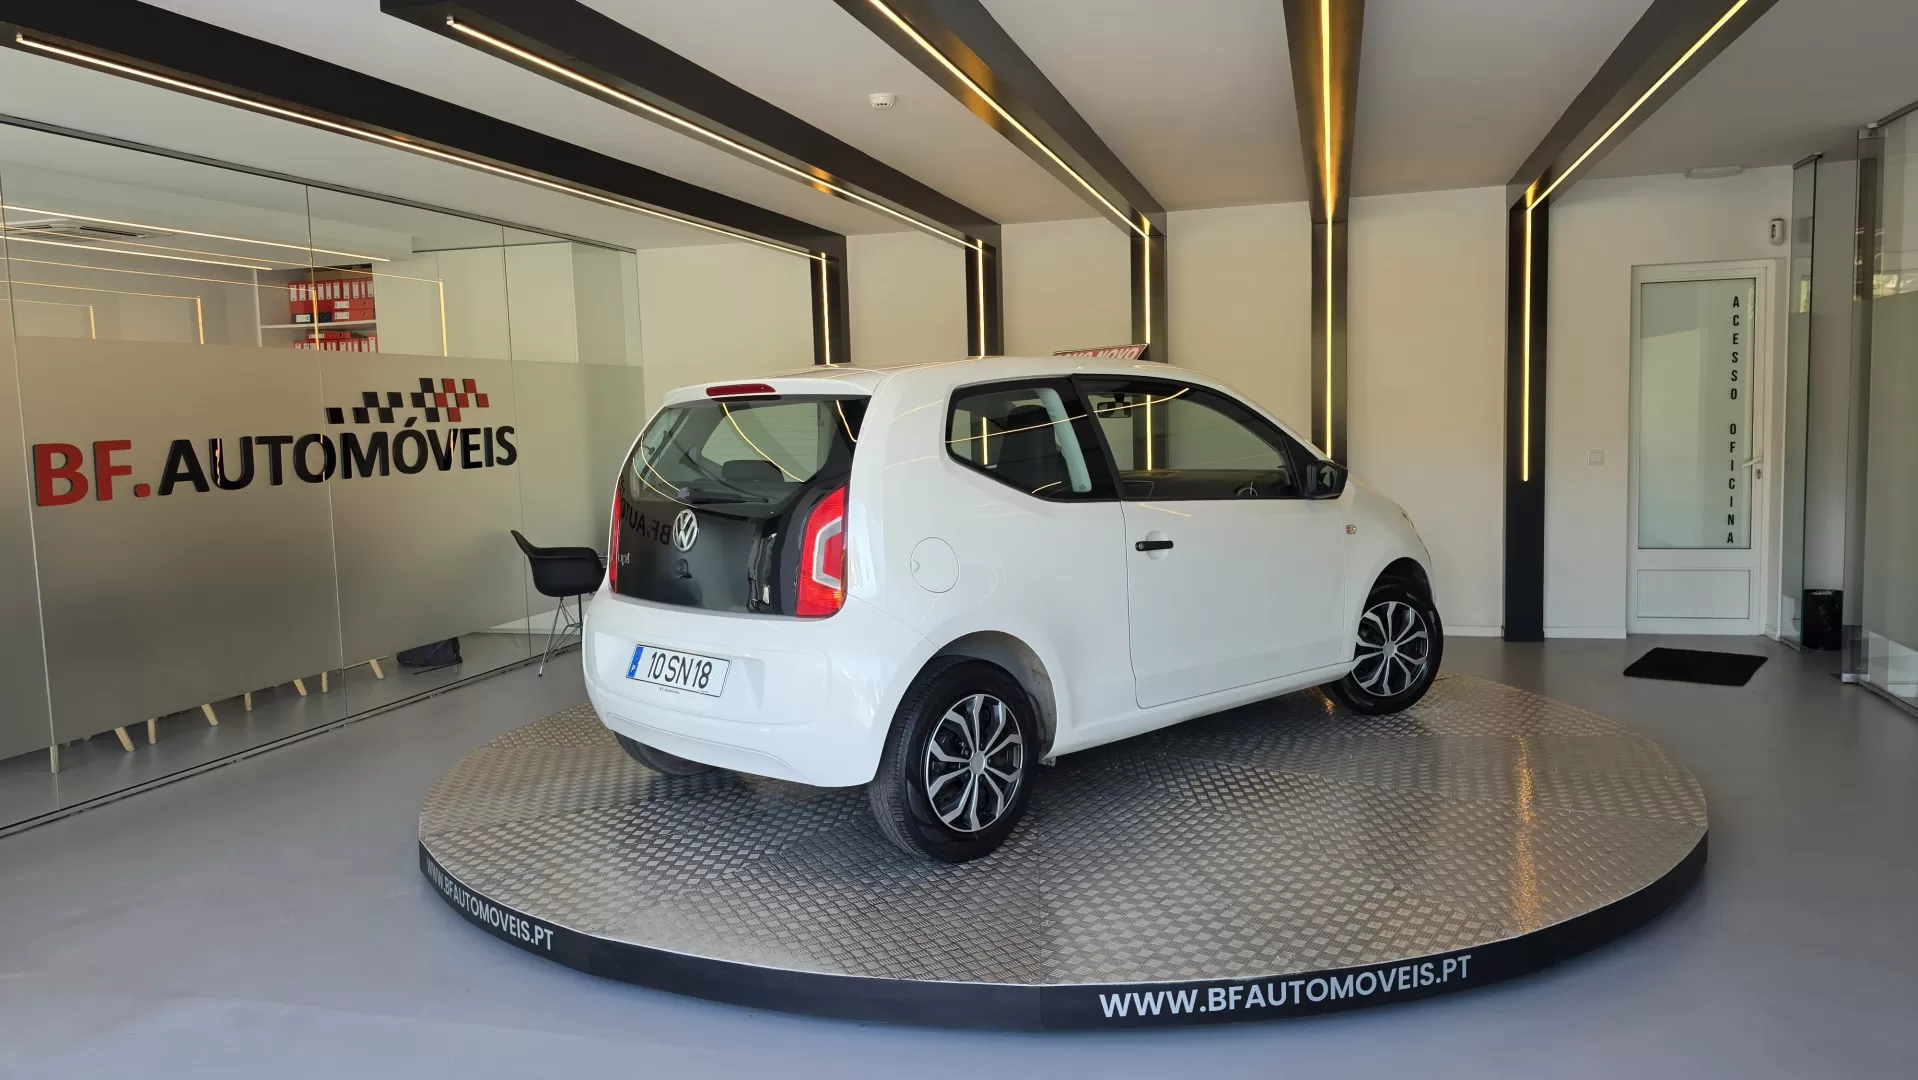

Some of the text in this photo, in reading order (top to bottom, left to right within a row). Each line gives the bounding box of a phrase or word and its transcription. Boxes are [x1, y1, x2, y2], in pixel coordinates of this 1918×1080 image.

[1726, 295, 1741, 544] ACESSO OFICINA
[426, 855, 554, 951] WWW.BFAUTOMOVEIS.PT
[1099, 954, 1472, 1018] WWW.BFAUTOMOVEIS.PT
